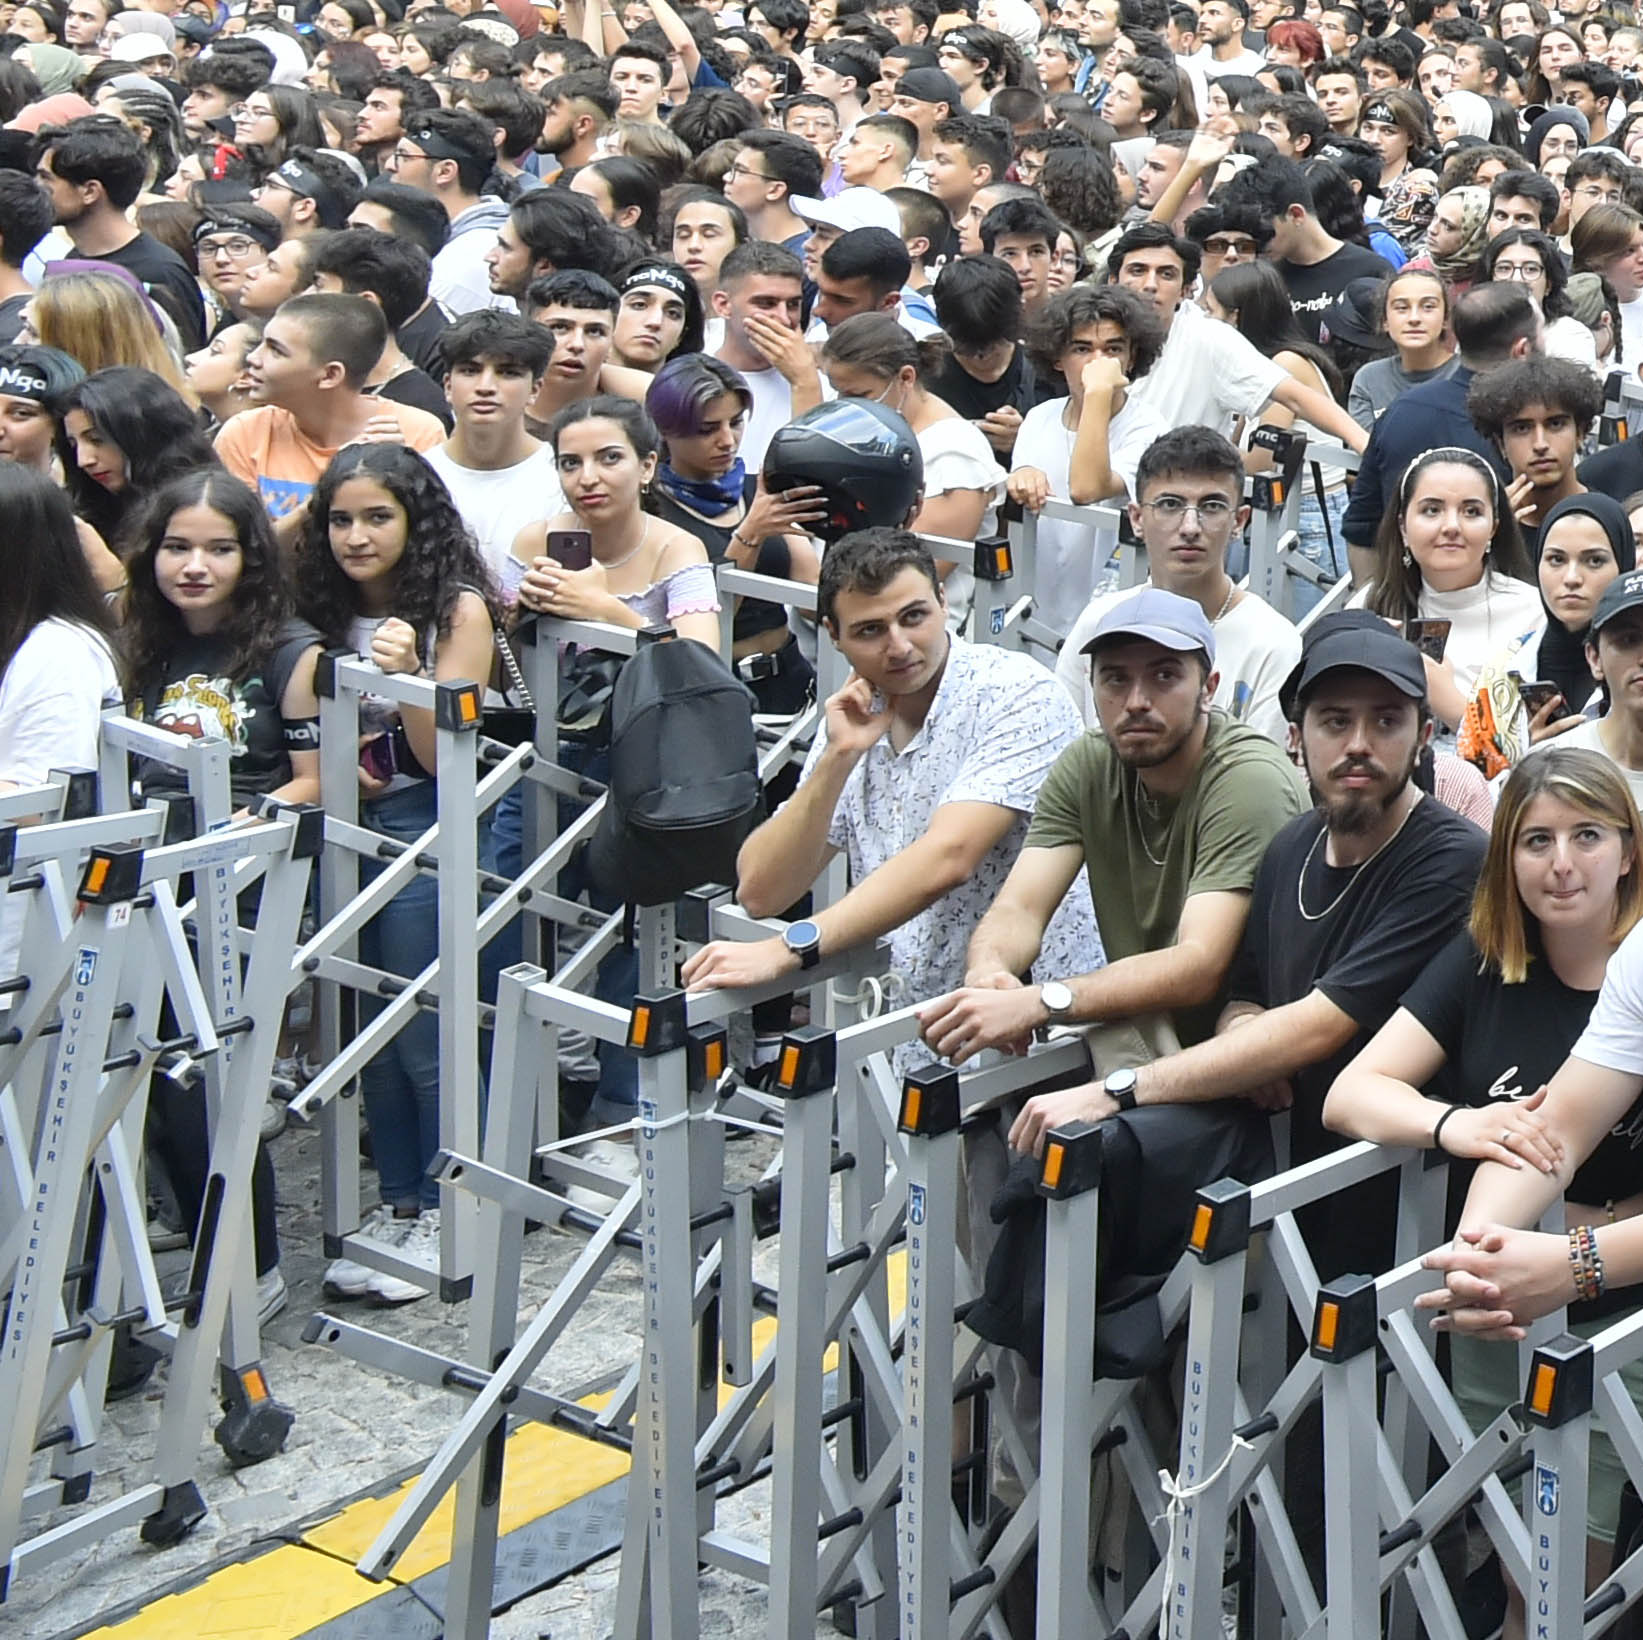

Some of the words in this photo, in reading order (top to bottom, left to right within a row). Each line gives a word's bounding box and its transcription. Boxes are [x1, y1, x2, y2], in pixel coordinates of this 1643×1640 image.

[112, 907, 128, 923] 74
[45, 989, 84, 1163] BÜYÜKŞEHİR
[12, 1182, 48, 1359] BELEDİYESİ
[910, 1235, 922, 1429] BÜYÜKŞEHİR
[650, 1353, 665, 1538] BELEDİYESİ
[1180, 1357, 1202, 1562] BÜYÜKŞHİR
